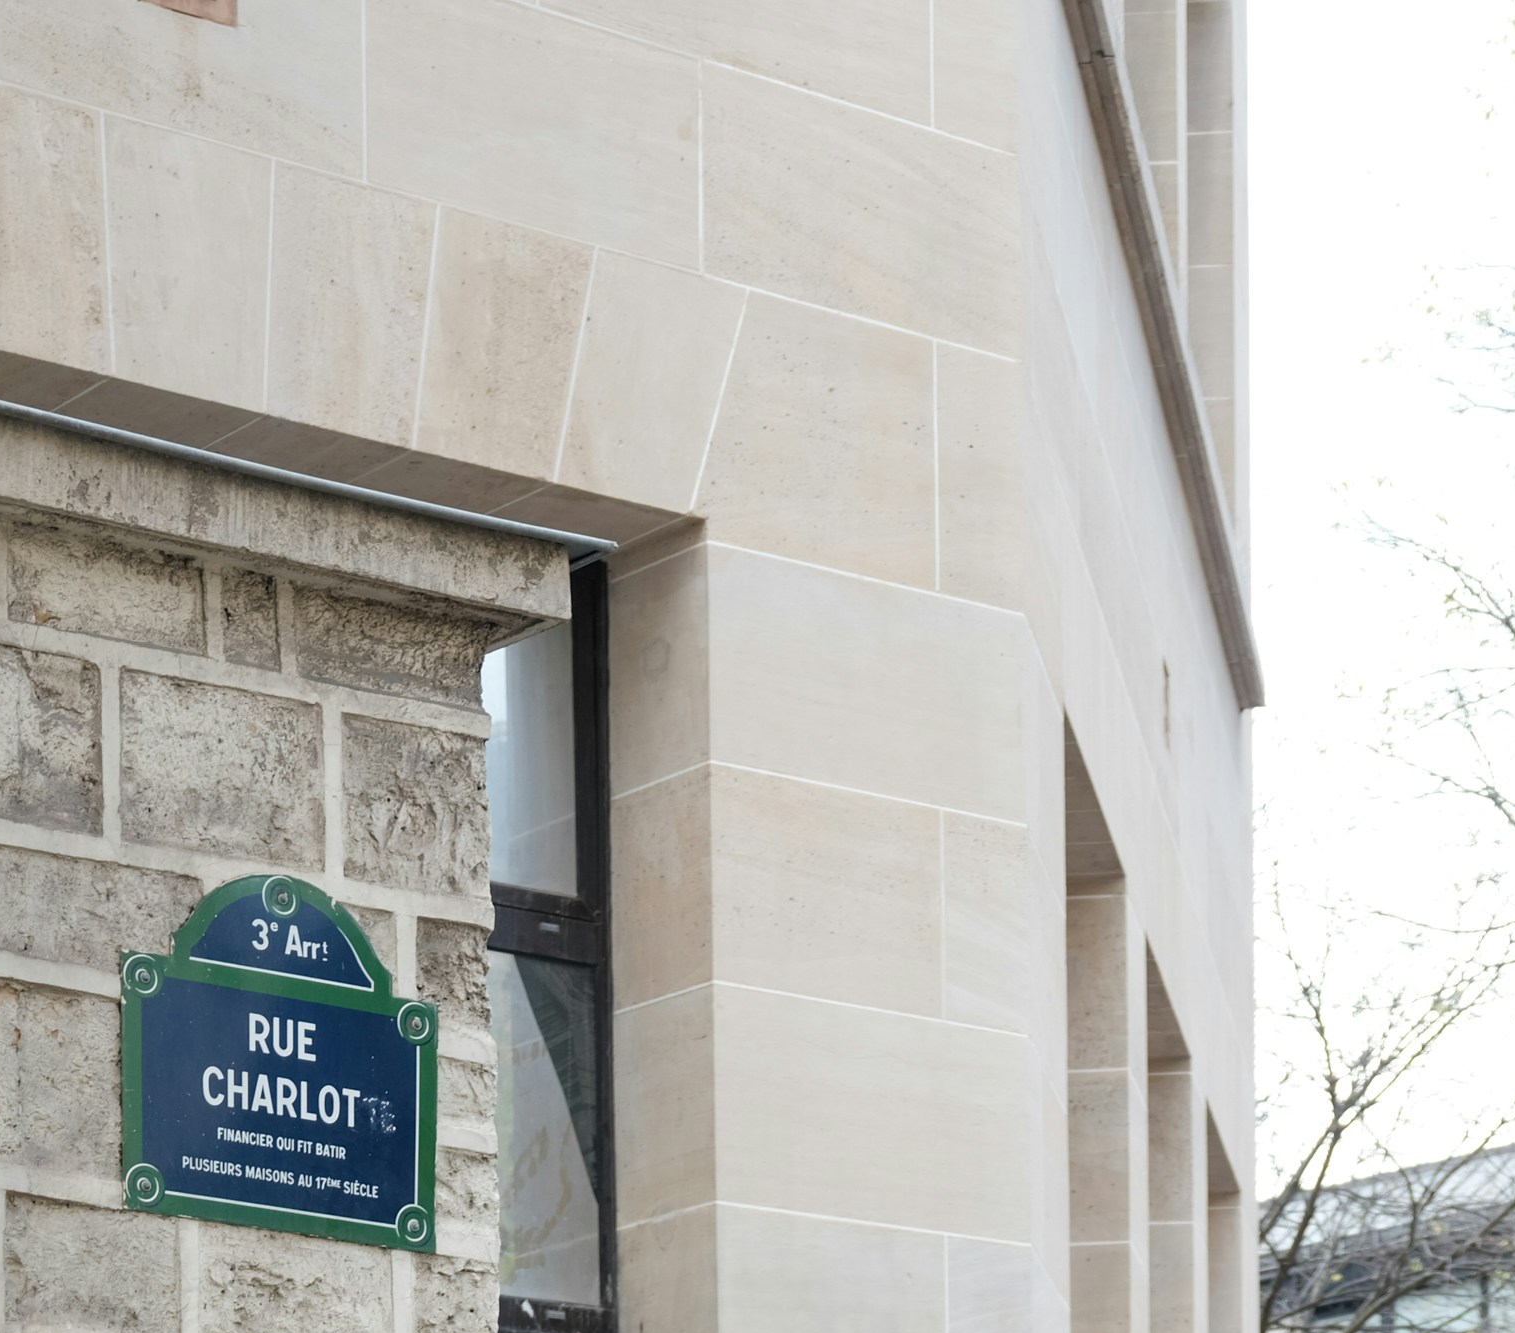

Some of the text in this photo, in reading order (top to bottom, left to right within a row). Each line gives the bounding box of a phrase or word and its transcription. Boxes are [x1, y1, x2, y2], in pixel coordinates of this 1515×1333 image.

[248, 1012, 317, 1062] RUE
[202, 1066, 361, 1128] CHARLOT
[217, 1127, 346, 1160] FINANCIER QUI FIT BATIR
[182, 1156, 243, 1177] PLUSIEURS
[245, 1165, 295, 1185] MAISONS
[298, 1174, 313, 1188] AU
[343, 1180, 379, 1199] SIÈCLE
